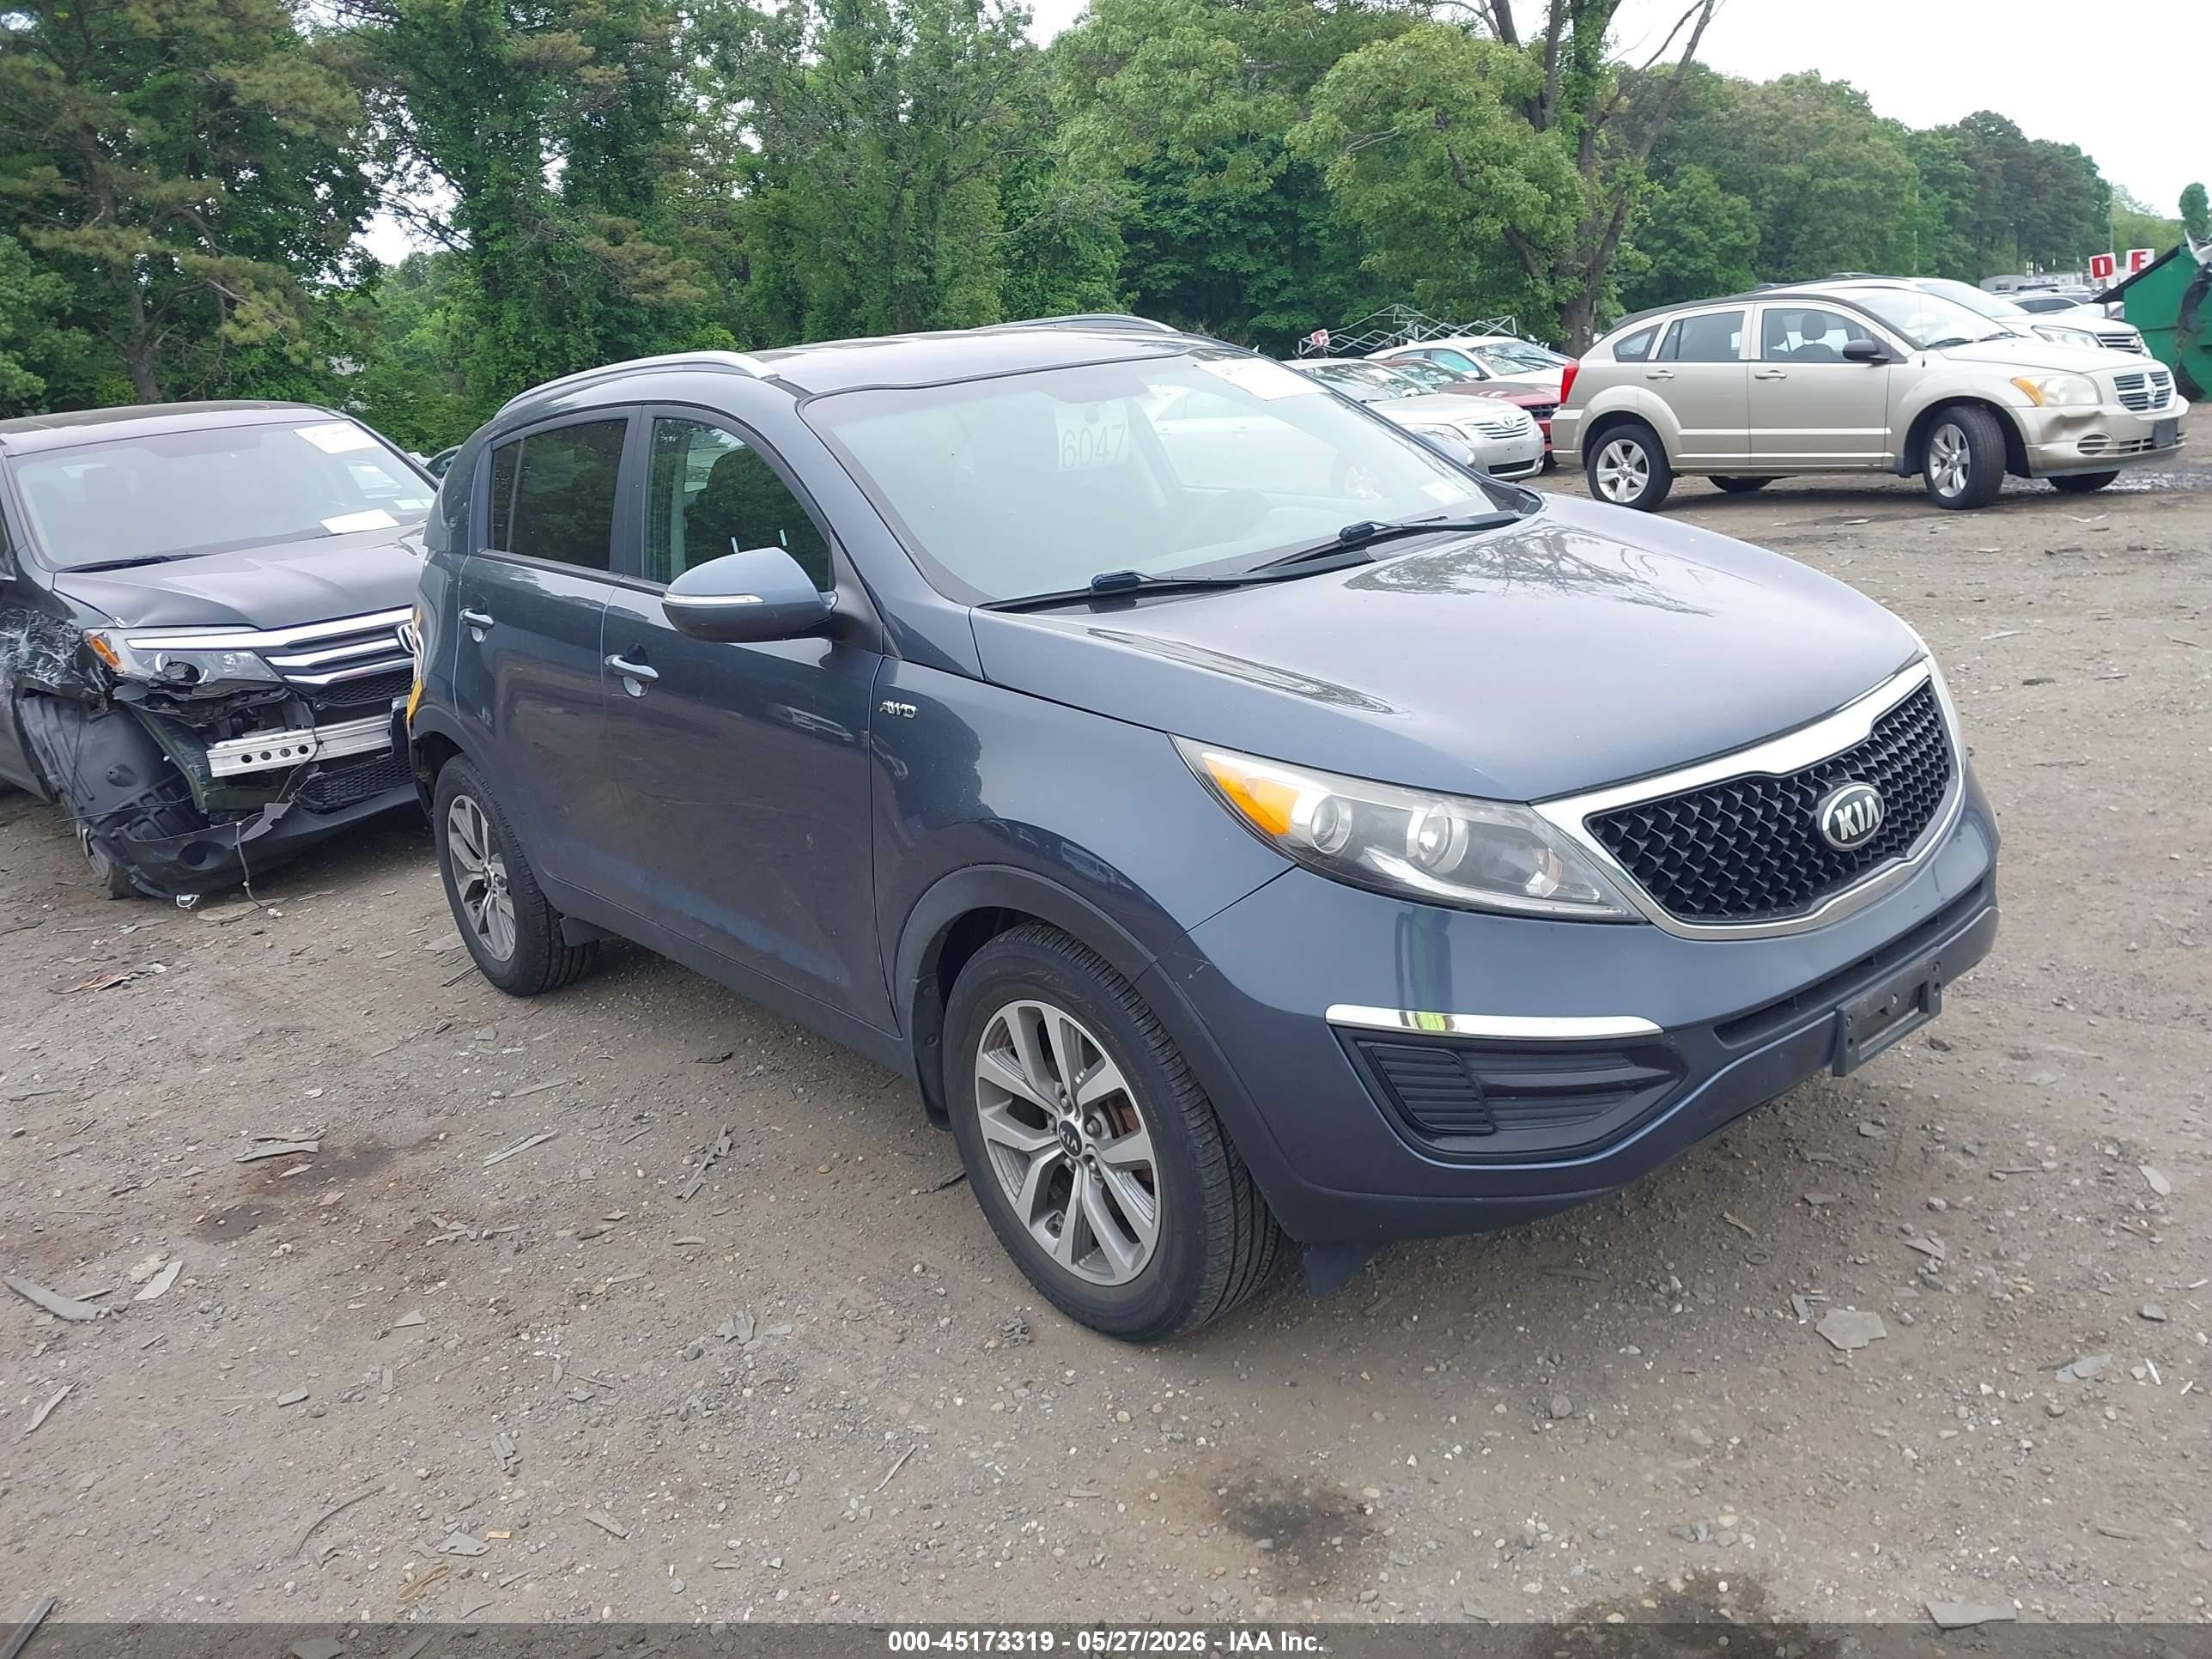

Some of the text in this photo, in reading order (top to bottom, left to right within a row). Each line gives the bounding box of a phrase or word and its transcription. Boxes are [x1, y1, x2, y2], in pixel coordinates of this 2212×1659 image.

[2092, 256, 2113, 278] D
[1062, 424, 1127, 469] 6047
[878, 700, 917, 719] AWD
[1833, 794, 1881, 841] KIA
[1060, 1127, 1079, 1152] KIA
